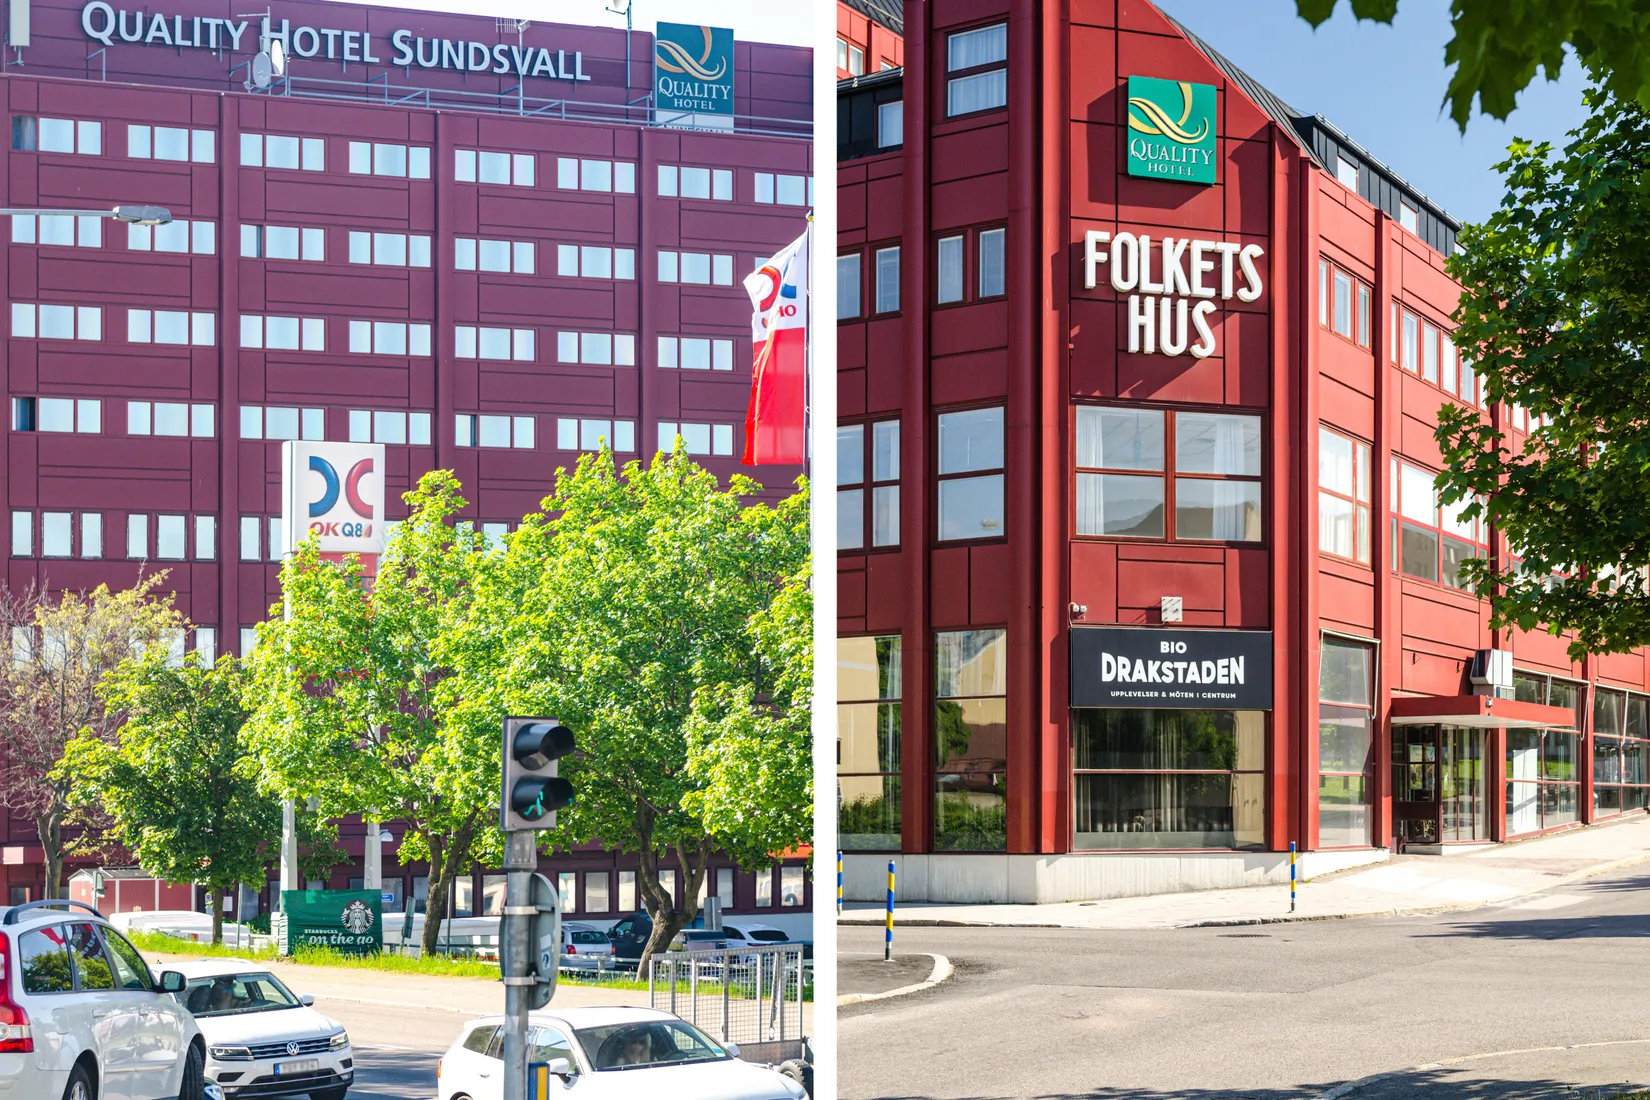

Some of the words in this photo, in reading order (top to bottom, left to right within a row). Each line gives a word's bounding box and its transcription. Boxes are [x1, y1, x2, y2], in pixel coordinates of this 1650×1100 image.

[81, 1, 249, 51] QUALITY
[261, 16, 380, 64] HOTEL
[392, 29, 591, 82] SUNDSVALL
[658, 76, 732, 100] QUALITY
[673, 98, 716, 111] HOTEL
[1130, 138, 1213, 165] QUALITY
[1148, 162, 1195, 176] HOTEL
[1085, 230, 1265, 303] FOLKETS
[1128, 295, 1218, 359] HUS
[1160, 641, 1188, 654] BIO
[1101, 652, 1245, 685] DRAKSTADEN
[1110, 690, 1159, 698] UPPLEVELSER
[1169, 690, 1194, 699] MÖTEN
[309, 935, 328, 945] on
[330, 932, 355, 945] the
